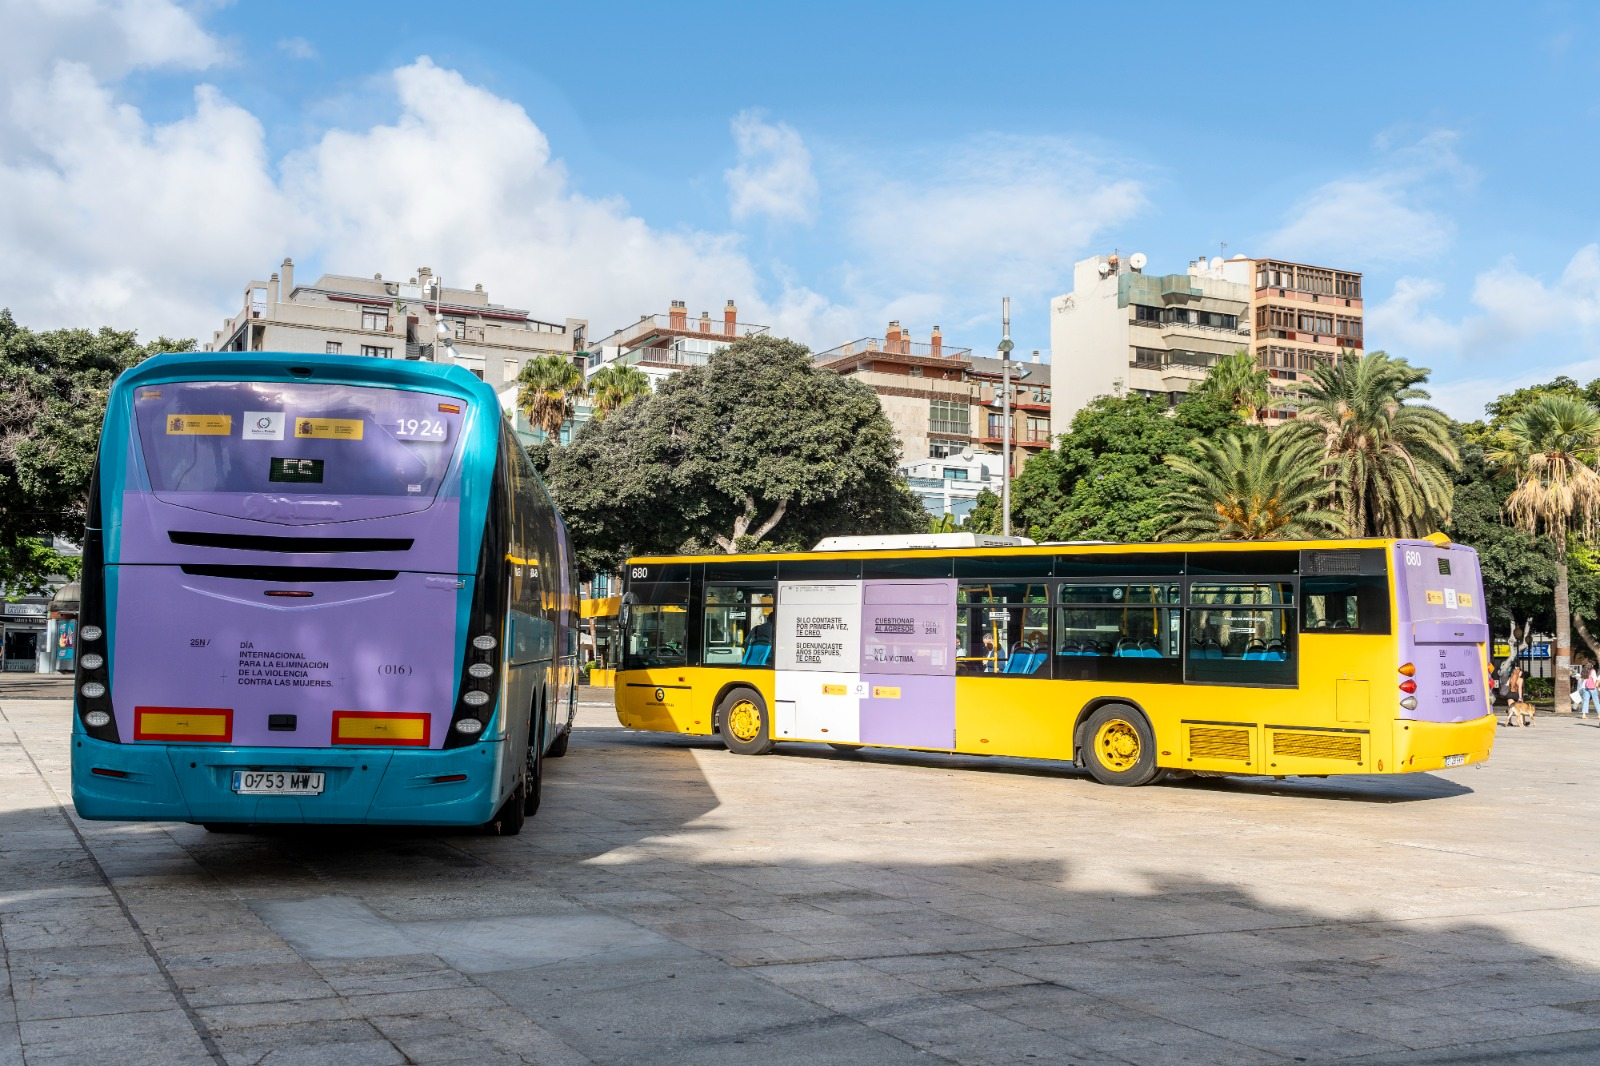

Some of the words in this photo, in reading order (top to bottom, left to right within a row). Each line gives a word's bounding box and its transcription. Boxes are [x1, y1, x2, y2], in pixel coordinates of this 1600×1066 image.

[396, 418, 444, 437] 1924
[1405, 551, 1422, 566] 680
[632, 568, 648, 578] 680
[240, 651, 306, 659] INTERNACIONAL
[245, 774, 284, 788] 0753
[290, 774, 320, 789] MWJ
